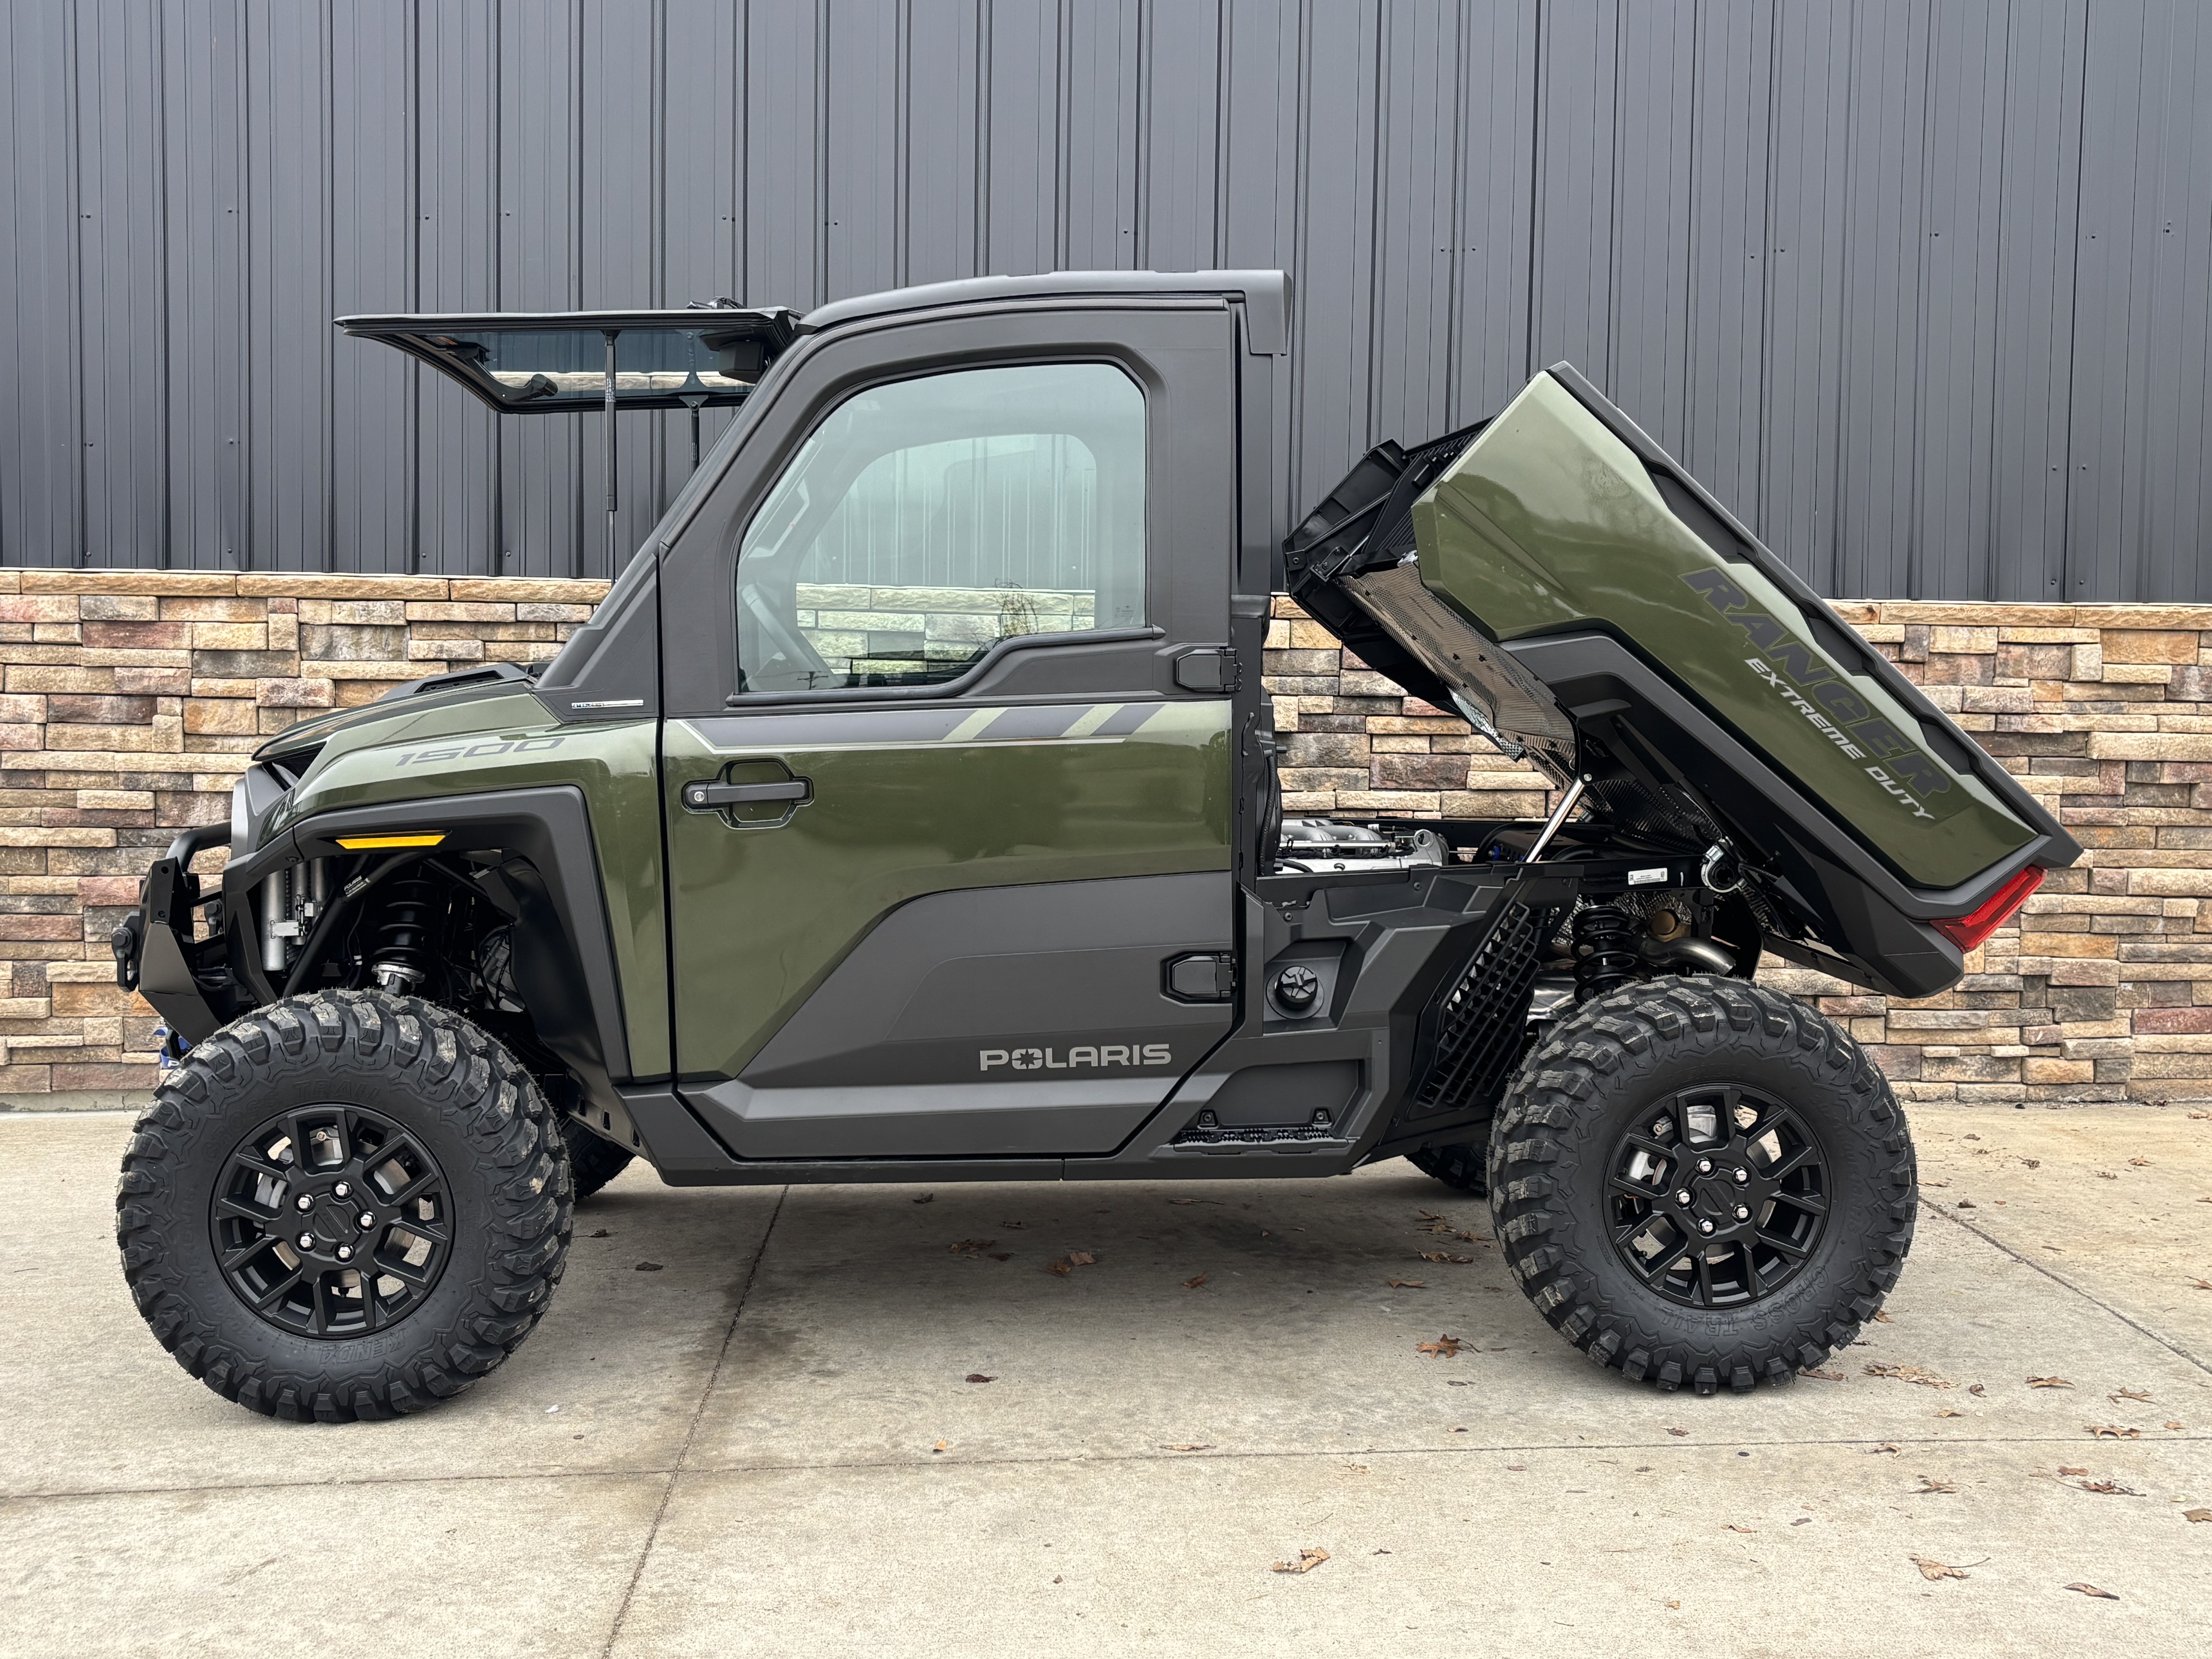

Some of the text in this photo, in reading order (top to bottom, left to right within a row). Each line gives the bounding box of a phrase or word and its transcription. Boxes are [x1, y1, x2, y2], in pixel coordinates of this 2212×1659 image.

[1678, 567, 1951, 798] RANGER
[395, 737, 565, 767] 1500
[1744, 658, 1936, 820] EXTREME DUTY
[980, 1044, 1171, 1071] POLARIS
[1661, 1266, 1828, 1336] CROSS TRAIL
[320, 1328, 406, 1364] KENDA
